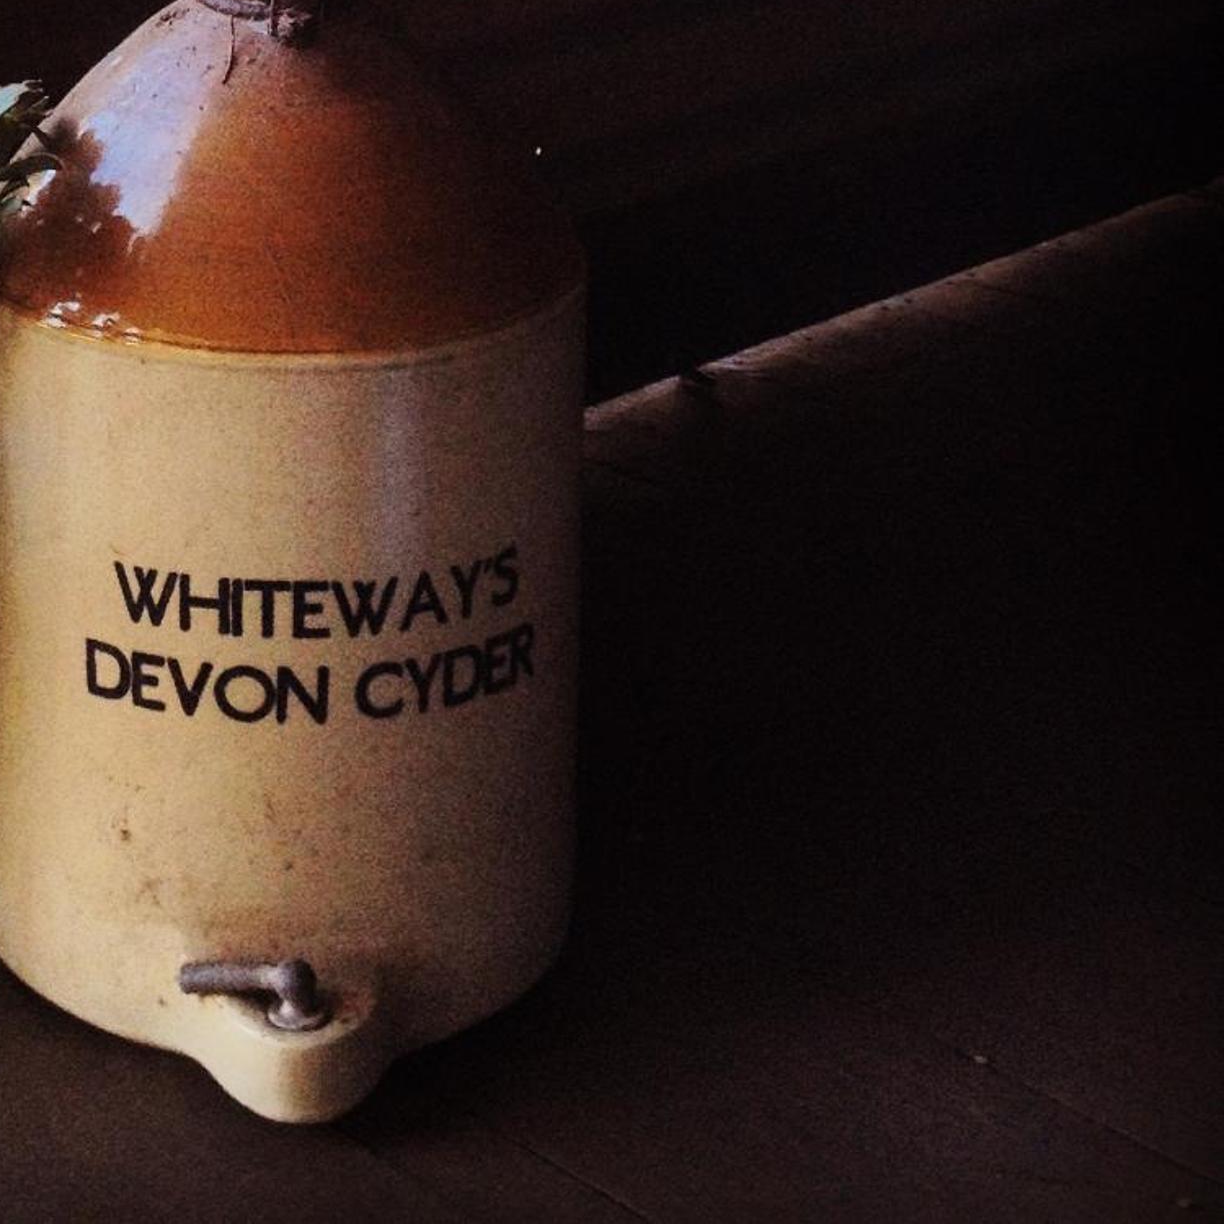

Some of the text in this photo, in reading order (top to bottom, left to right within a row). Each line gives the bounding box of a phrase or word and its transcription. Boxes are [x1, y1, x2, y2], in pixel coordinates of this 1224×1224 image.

[114, 545, 519, 639] WHITEWAY'S
[85, 623, 535, 725] DEVON CYDER
